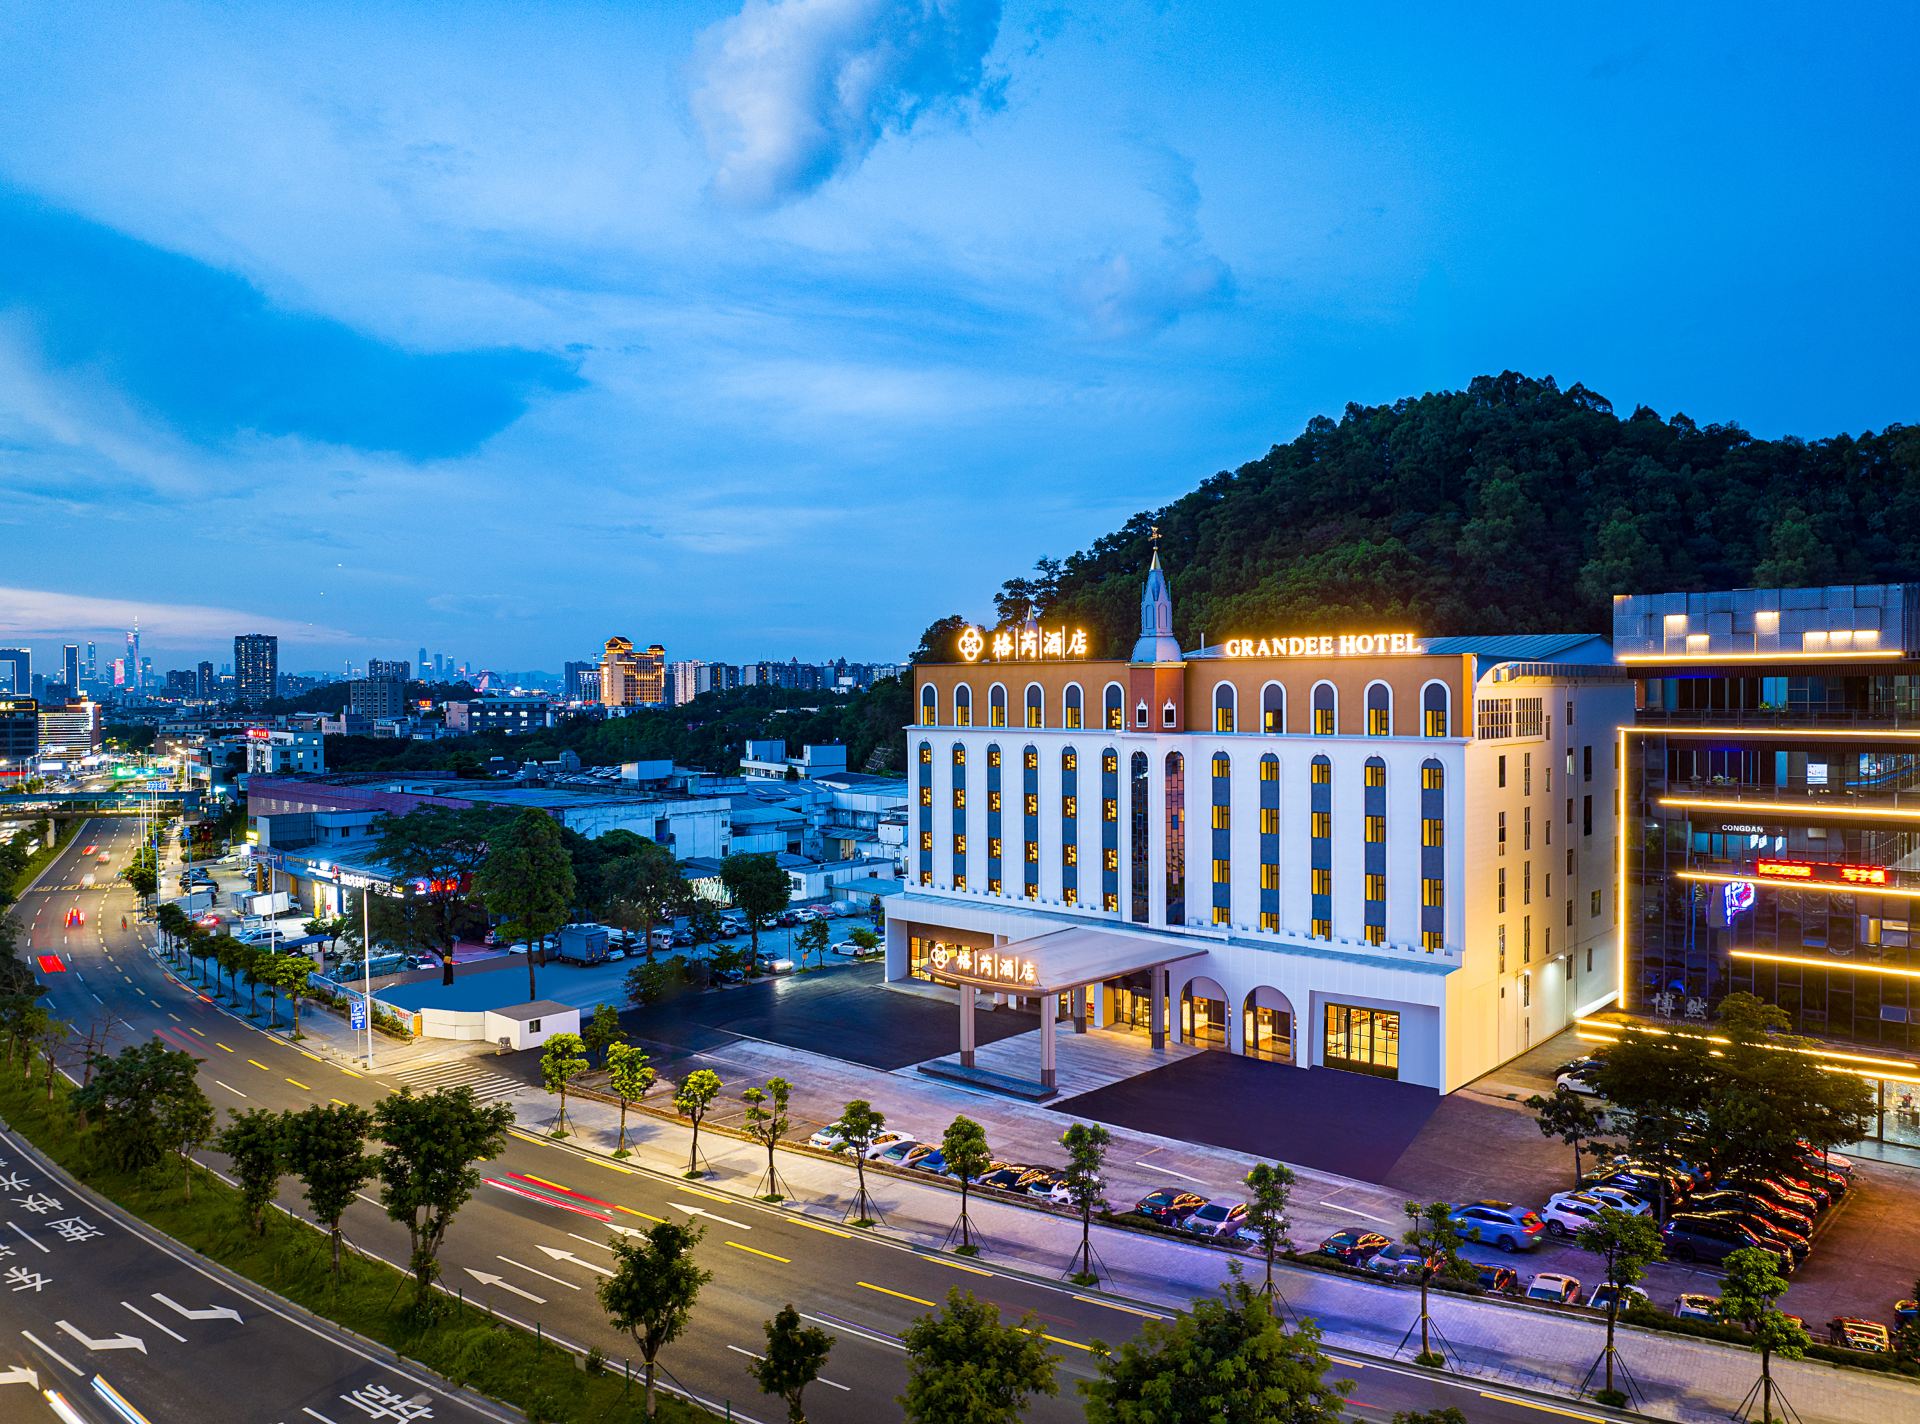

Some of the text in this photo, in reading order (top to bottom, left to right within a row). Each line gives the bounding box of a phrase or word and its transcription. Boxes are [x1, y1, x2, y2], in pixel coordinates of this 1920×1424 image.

[992, 629, 1087, 658] 格芮酒店
[1226, 633, 1422, 657] GRANDEE HOTEL
[1721, 824, 1764, 833] CONGDAN
[957, 950, 1036, 981] 格芮酒店
[1650, 992, 1707, 1020] 博然
